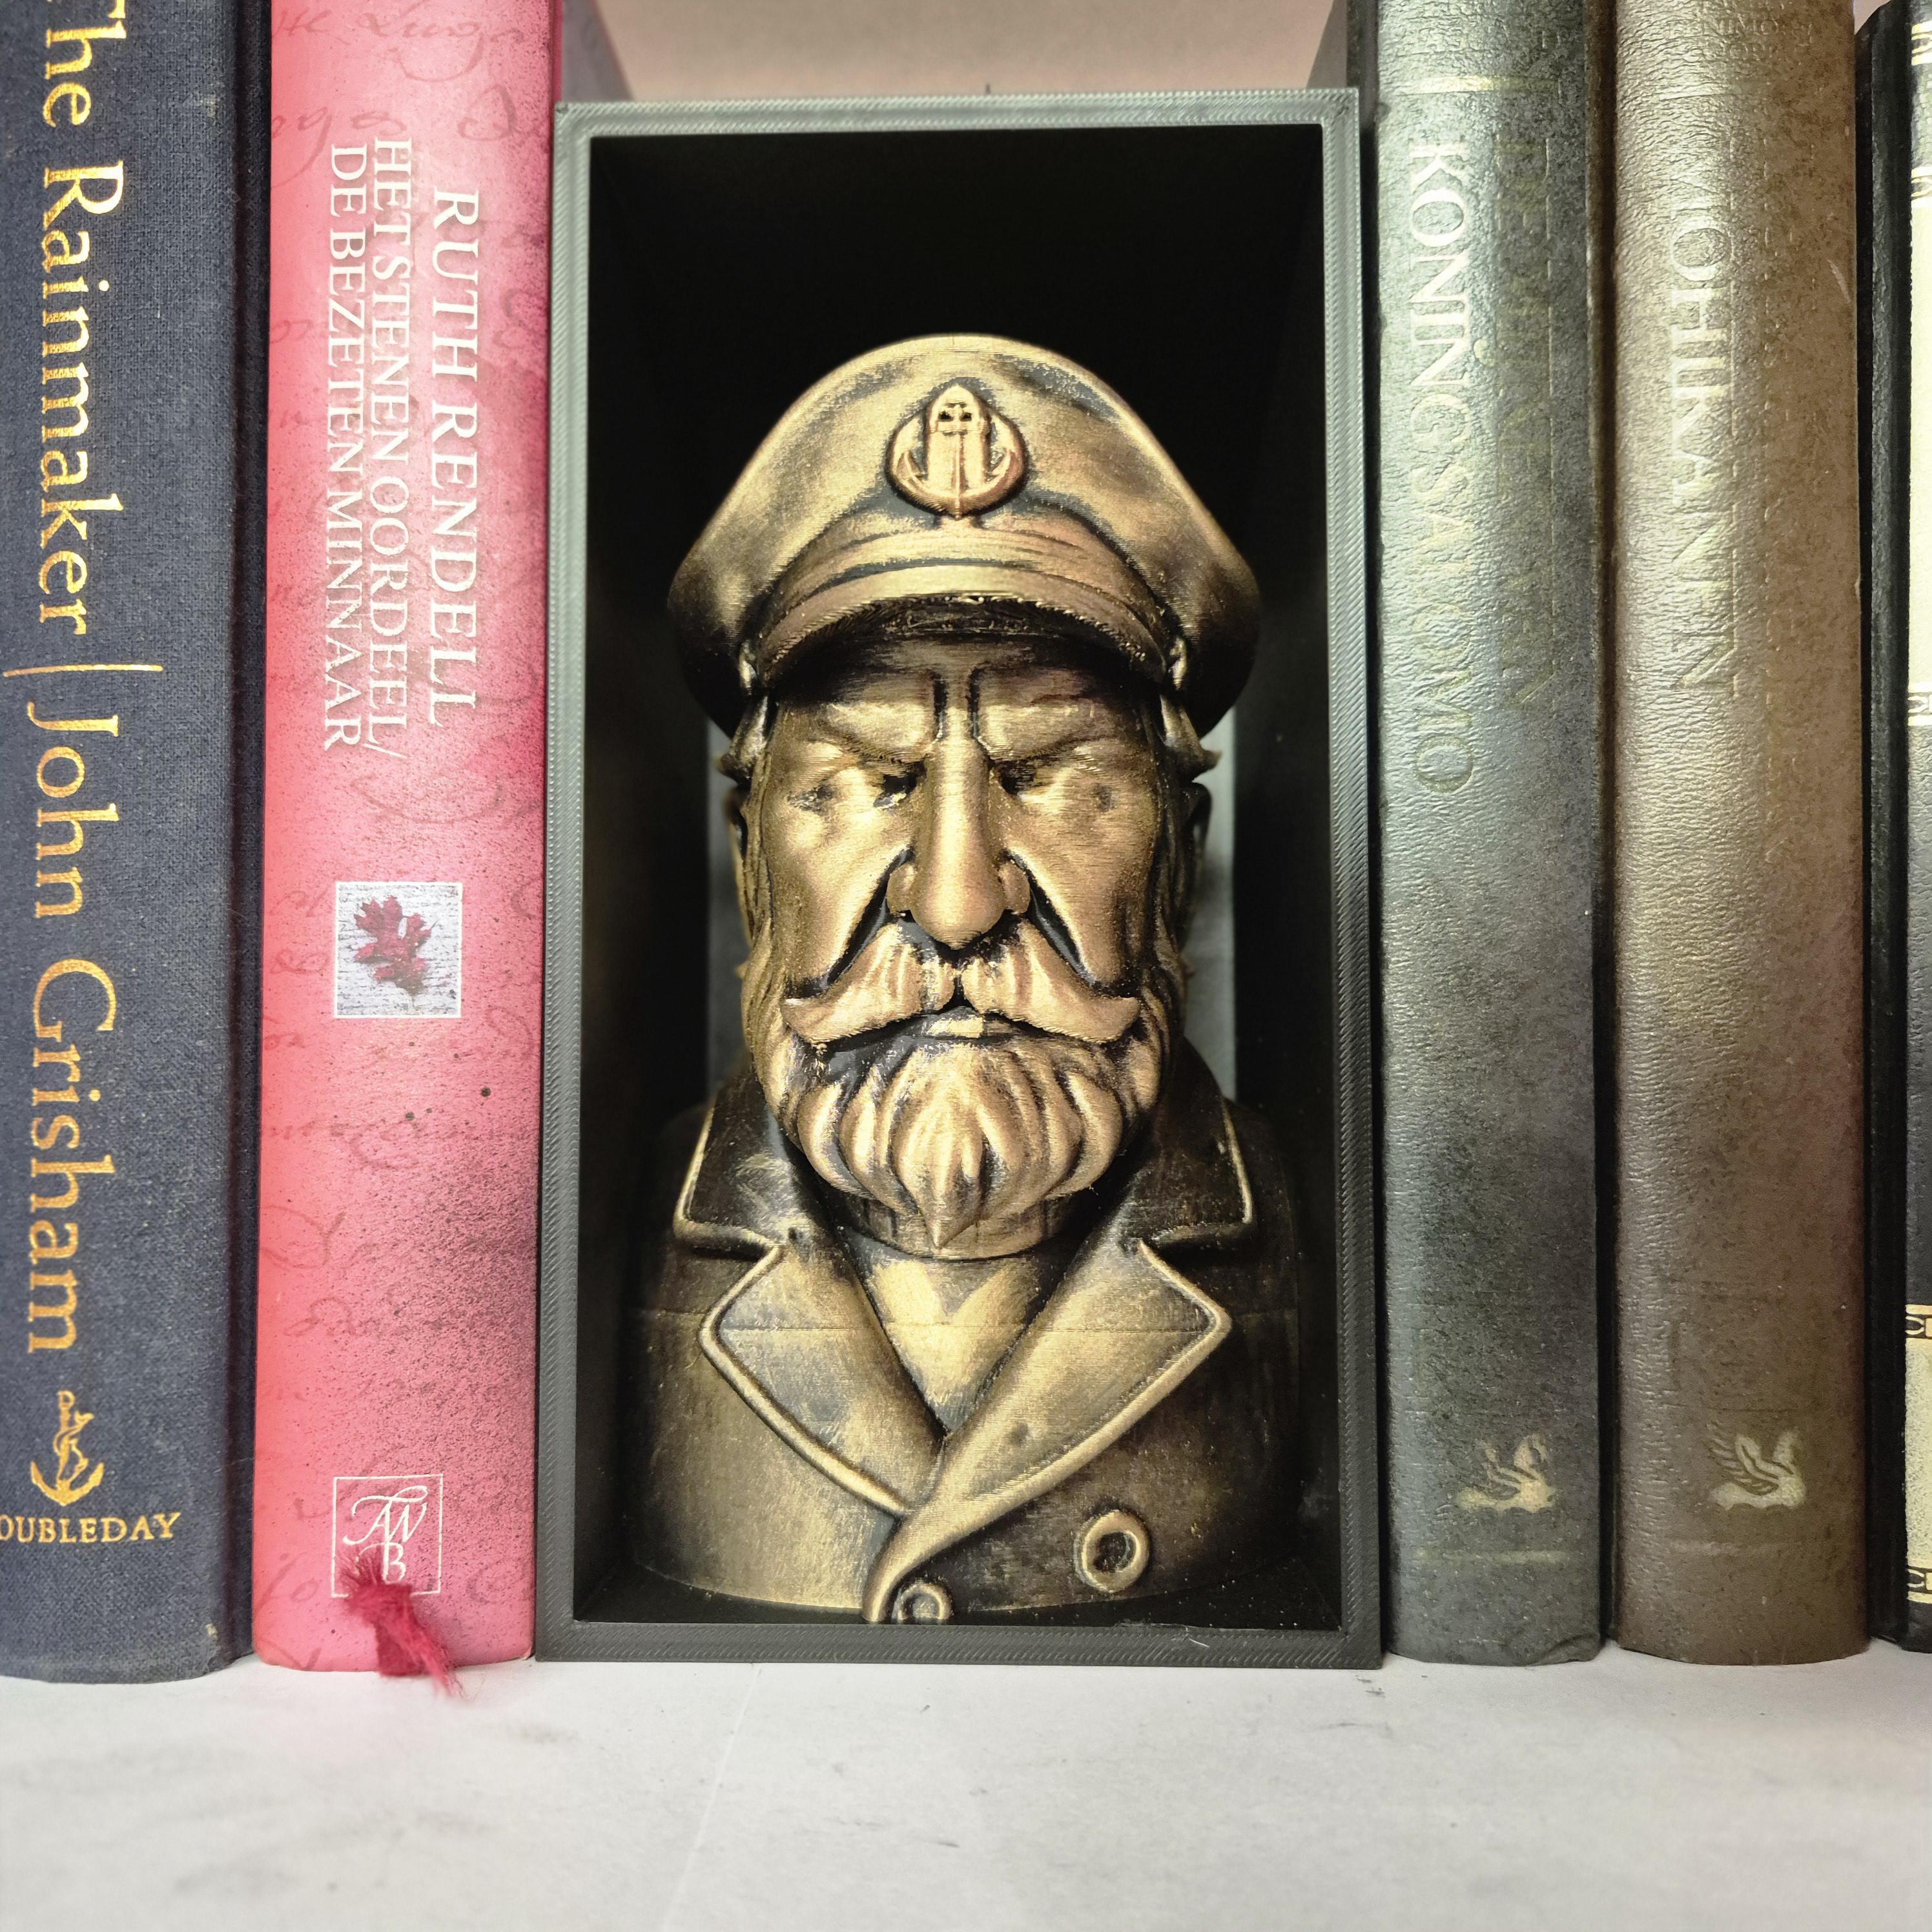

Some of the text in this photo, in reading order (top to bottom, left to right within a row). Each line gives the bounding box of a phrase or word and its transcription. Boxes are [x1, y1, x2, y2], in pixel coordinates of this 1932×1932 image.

[39, 159, 125, 635] Rainmaker
[369, 255, 411, 465] STENEN
[373, 136, 412, 246] HET
[1410, 139, 1473, 446] KONING
[324, 143, 367, 752] DE BEZETEN MINNAAR
[430, 185, 479, 728] RUTH RENDELL
[27, 701, 119, 1353] John Grisham
